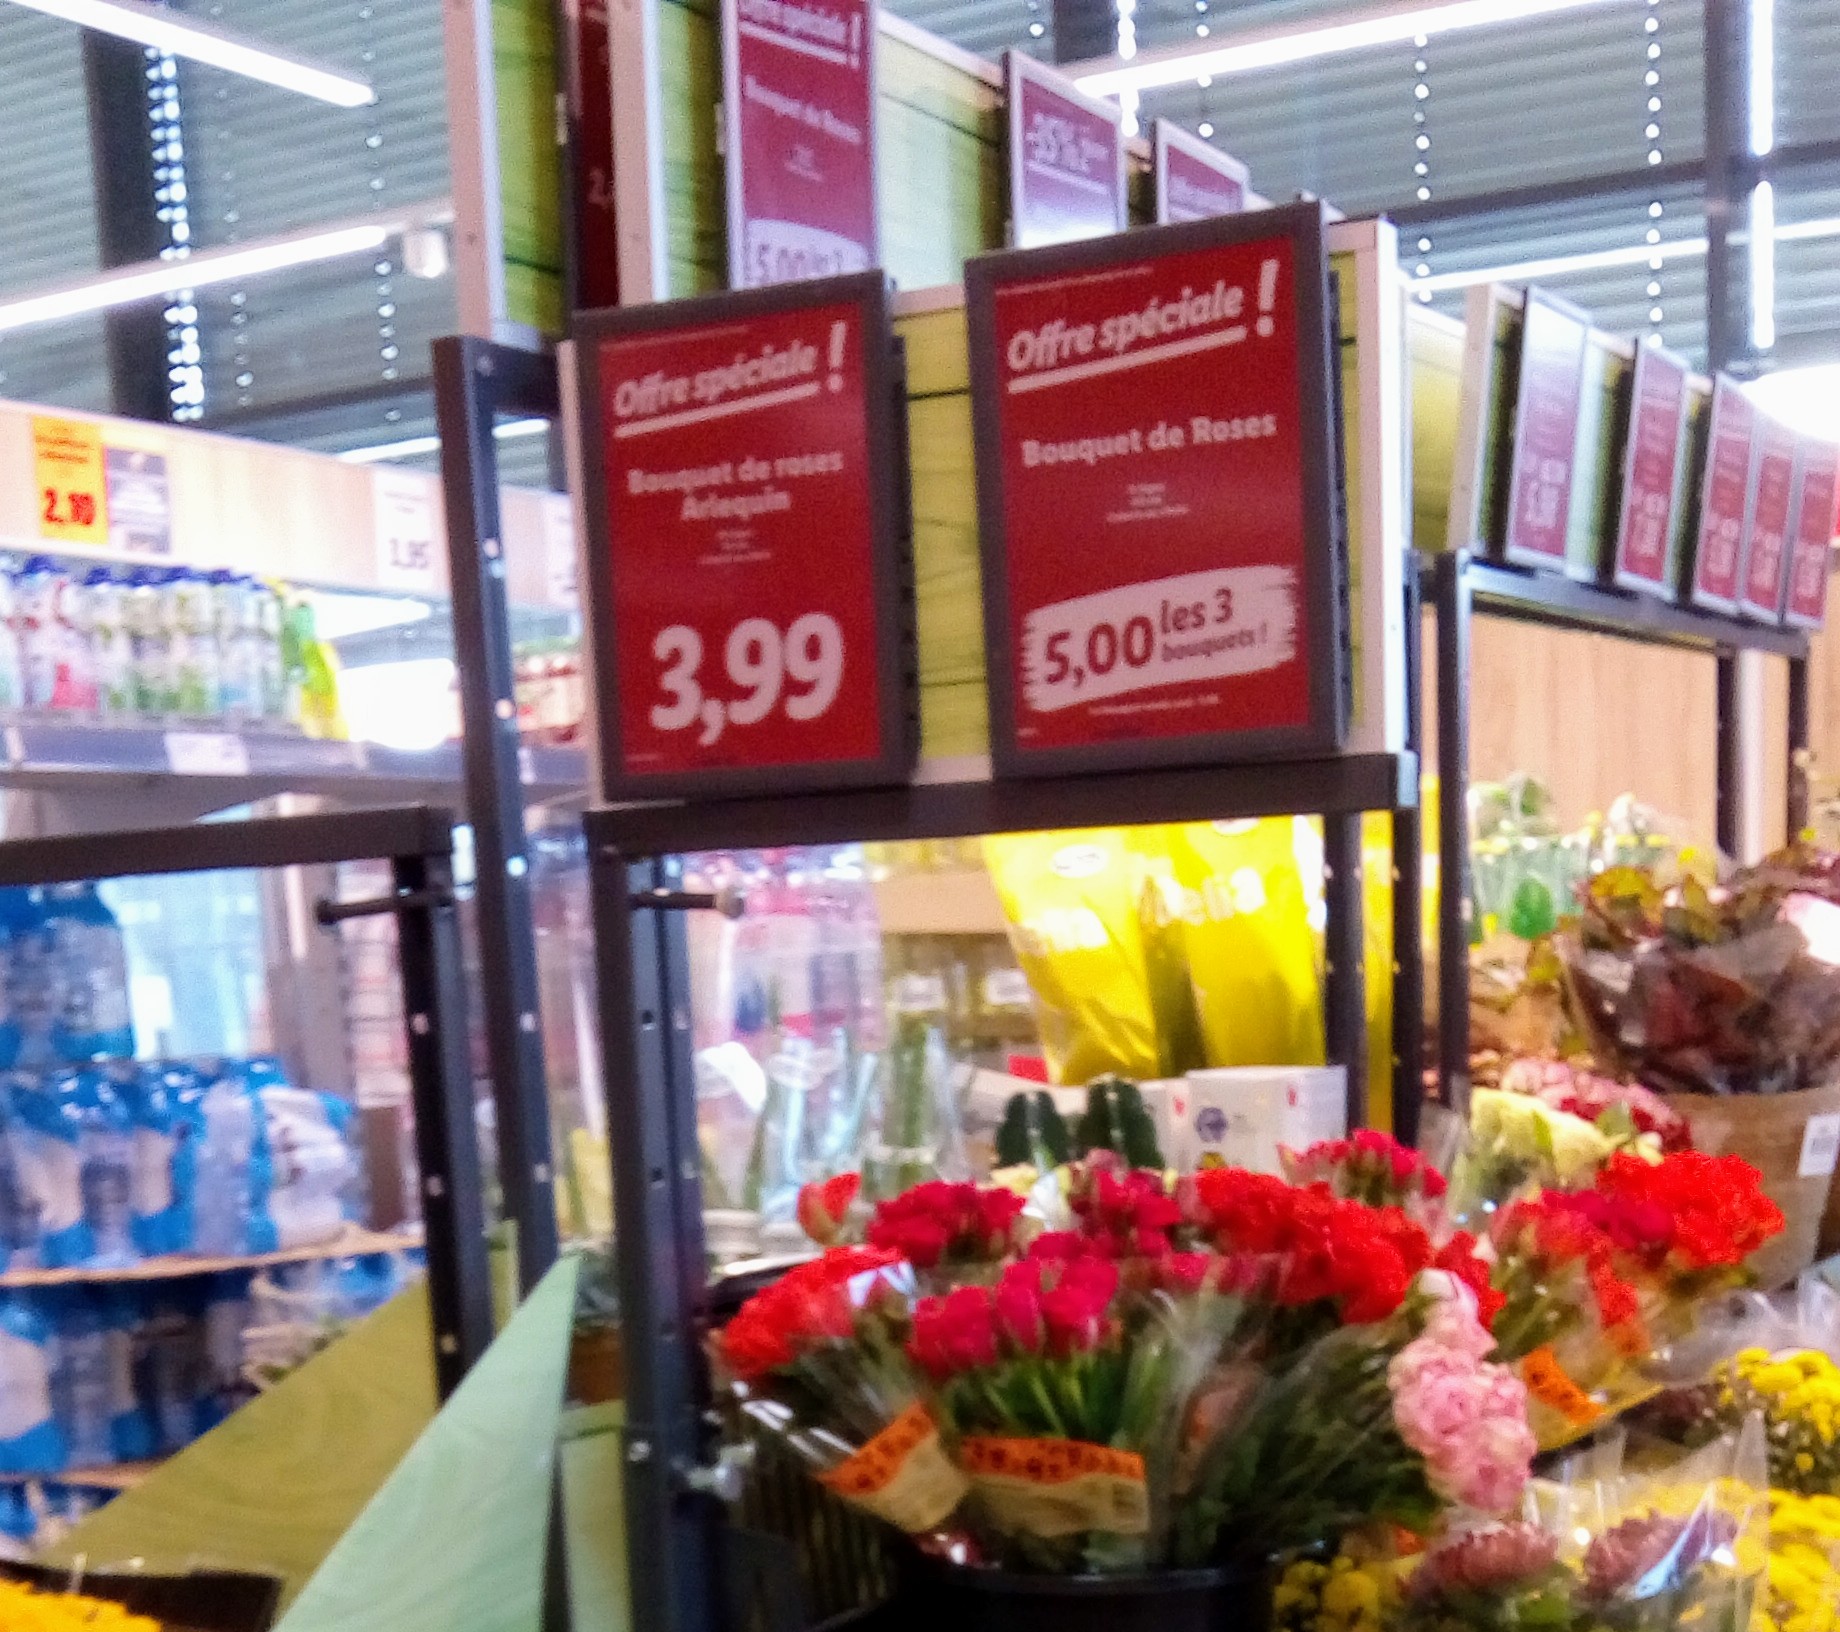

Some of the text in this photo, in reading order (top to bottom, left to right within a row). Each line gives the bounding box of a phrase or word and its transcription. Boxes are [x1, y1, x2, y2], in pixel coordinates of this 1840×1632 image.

[1007, 318, 1096, 372] Offre
[1099, 279, 1244, 352] spéciale
[1256, 258, 1280, 338] !
[613, 320, 847, 418] Offre spéciale !
[628, 451, 844, 496] Bouquet de roses
[1021, 413, 1277, 468] Bouquet de Roses
[680, 485, 792, 521] Arlequin
[1044, 587, 1233, 688] 5,00 les 3
[1160, 627, 1256, 663] bouquets
[651, 611, 845, 747] 3,99
